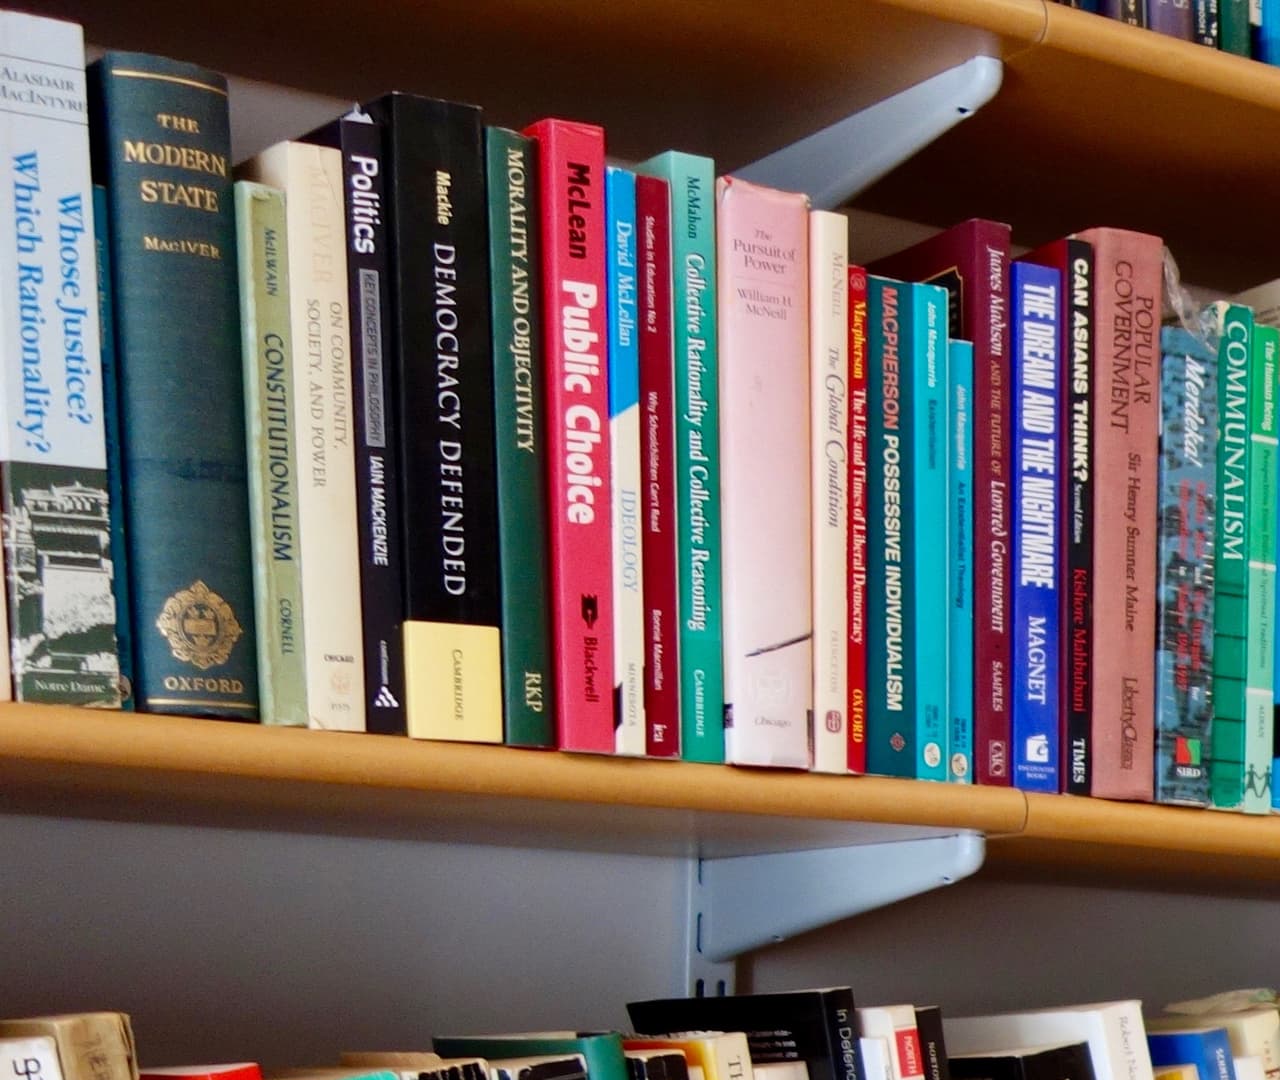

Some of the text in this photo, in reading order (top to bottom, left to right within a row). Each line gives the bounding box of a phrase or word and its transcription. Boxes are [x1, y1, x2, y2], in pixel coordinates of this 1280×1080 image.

[124, 140, 227, 177] MODERN
[157, 114, 199, 133] THE
[141, 180, 218, 212] STATE
[351, 155, 380, 254] Politics
[13, 150, 50, 453] Which Rationality?
[56, 193, 91, 425] Whose Justice?
[508, 148, 535, 453] MORALITY AND OBJECTIVITY
[562, 162, 602, 525] McLean Public Choice
[1110, 260, 1133, 434] GOVERNMENT
[1133, 296, 1153, 405] POPULAR
[434, 170, 467, 596] Mackie DEMOCRACY DEFENDED
[1073, 258, 1089, 481] CAN ASIANS THINK?
[264, 333, 294, 561] CONSTITUTIONALISM
[1020, 284, 1055, 589] THE DREAM AND THE NIGHTMARE
[1222, 320, 1248, 561] COMMUNALISM
[621, 489, 639, 592] IDEOLOGY
[882, 286, 903, 711] MACPHERSON POSSESSIVE INDIVIDUALISM
[279, 598, 294, 656] CORNELL
[583, 636, 599, 703] Blackwell
[1027, 616, 1047, 704] MAGNET
[35, 679, 106, 694] Notre Dame
[165, 676, 243, 694] OXFORD
[525, 672, 542, 712] RKP
[852, 688, 864, 743] OXFORD
[1072, 739, 1086, 784] TIMES
